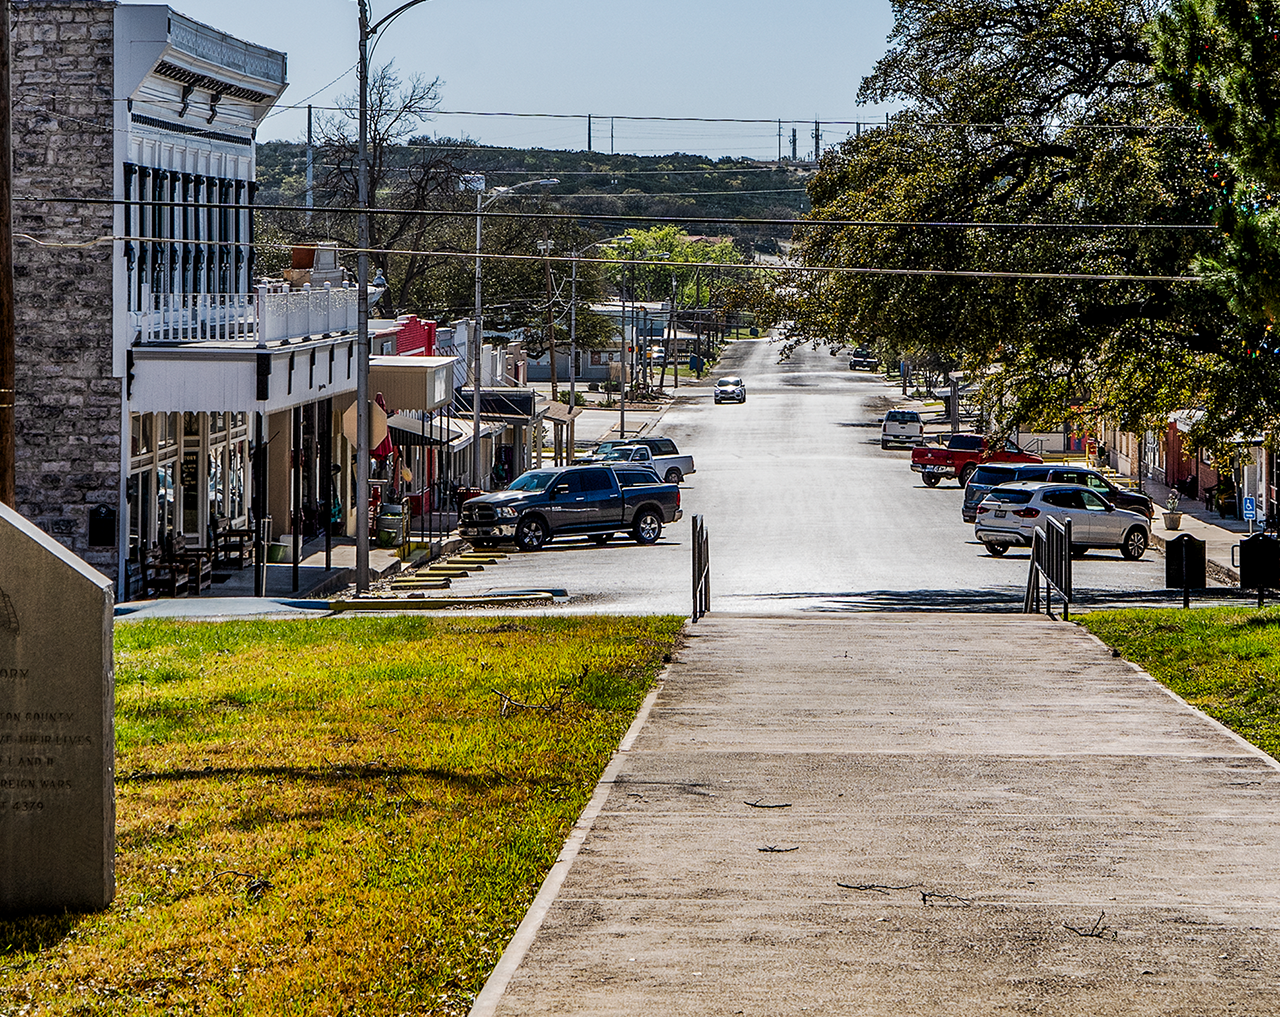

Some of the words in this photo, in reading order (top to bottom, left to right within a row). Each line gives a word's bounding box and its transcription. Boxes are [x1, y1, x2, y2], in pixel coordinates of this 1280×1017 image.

[24, 711, 75, 723] COUNTY
[18, 734, 53, 745] THEIR
[55, 734, 93, 746] LIVES
[18, 756, 43, 767] AND
[39, 778, 73, 790] WARS
[12, 801, 45, 812] 4379
